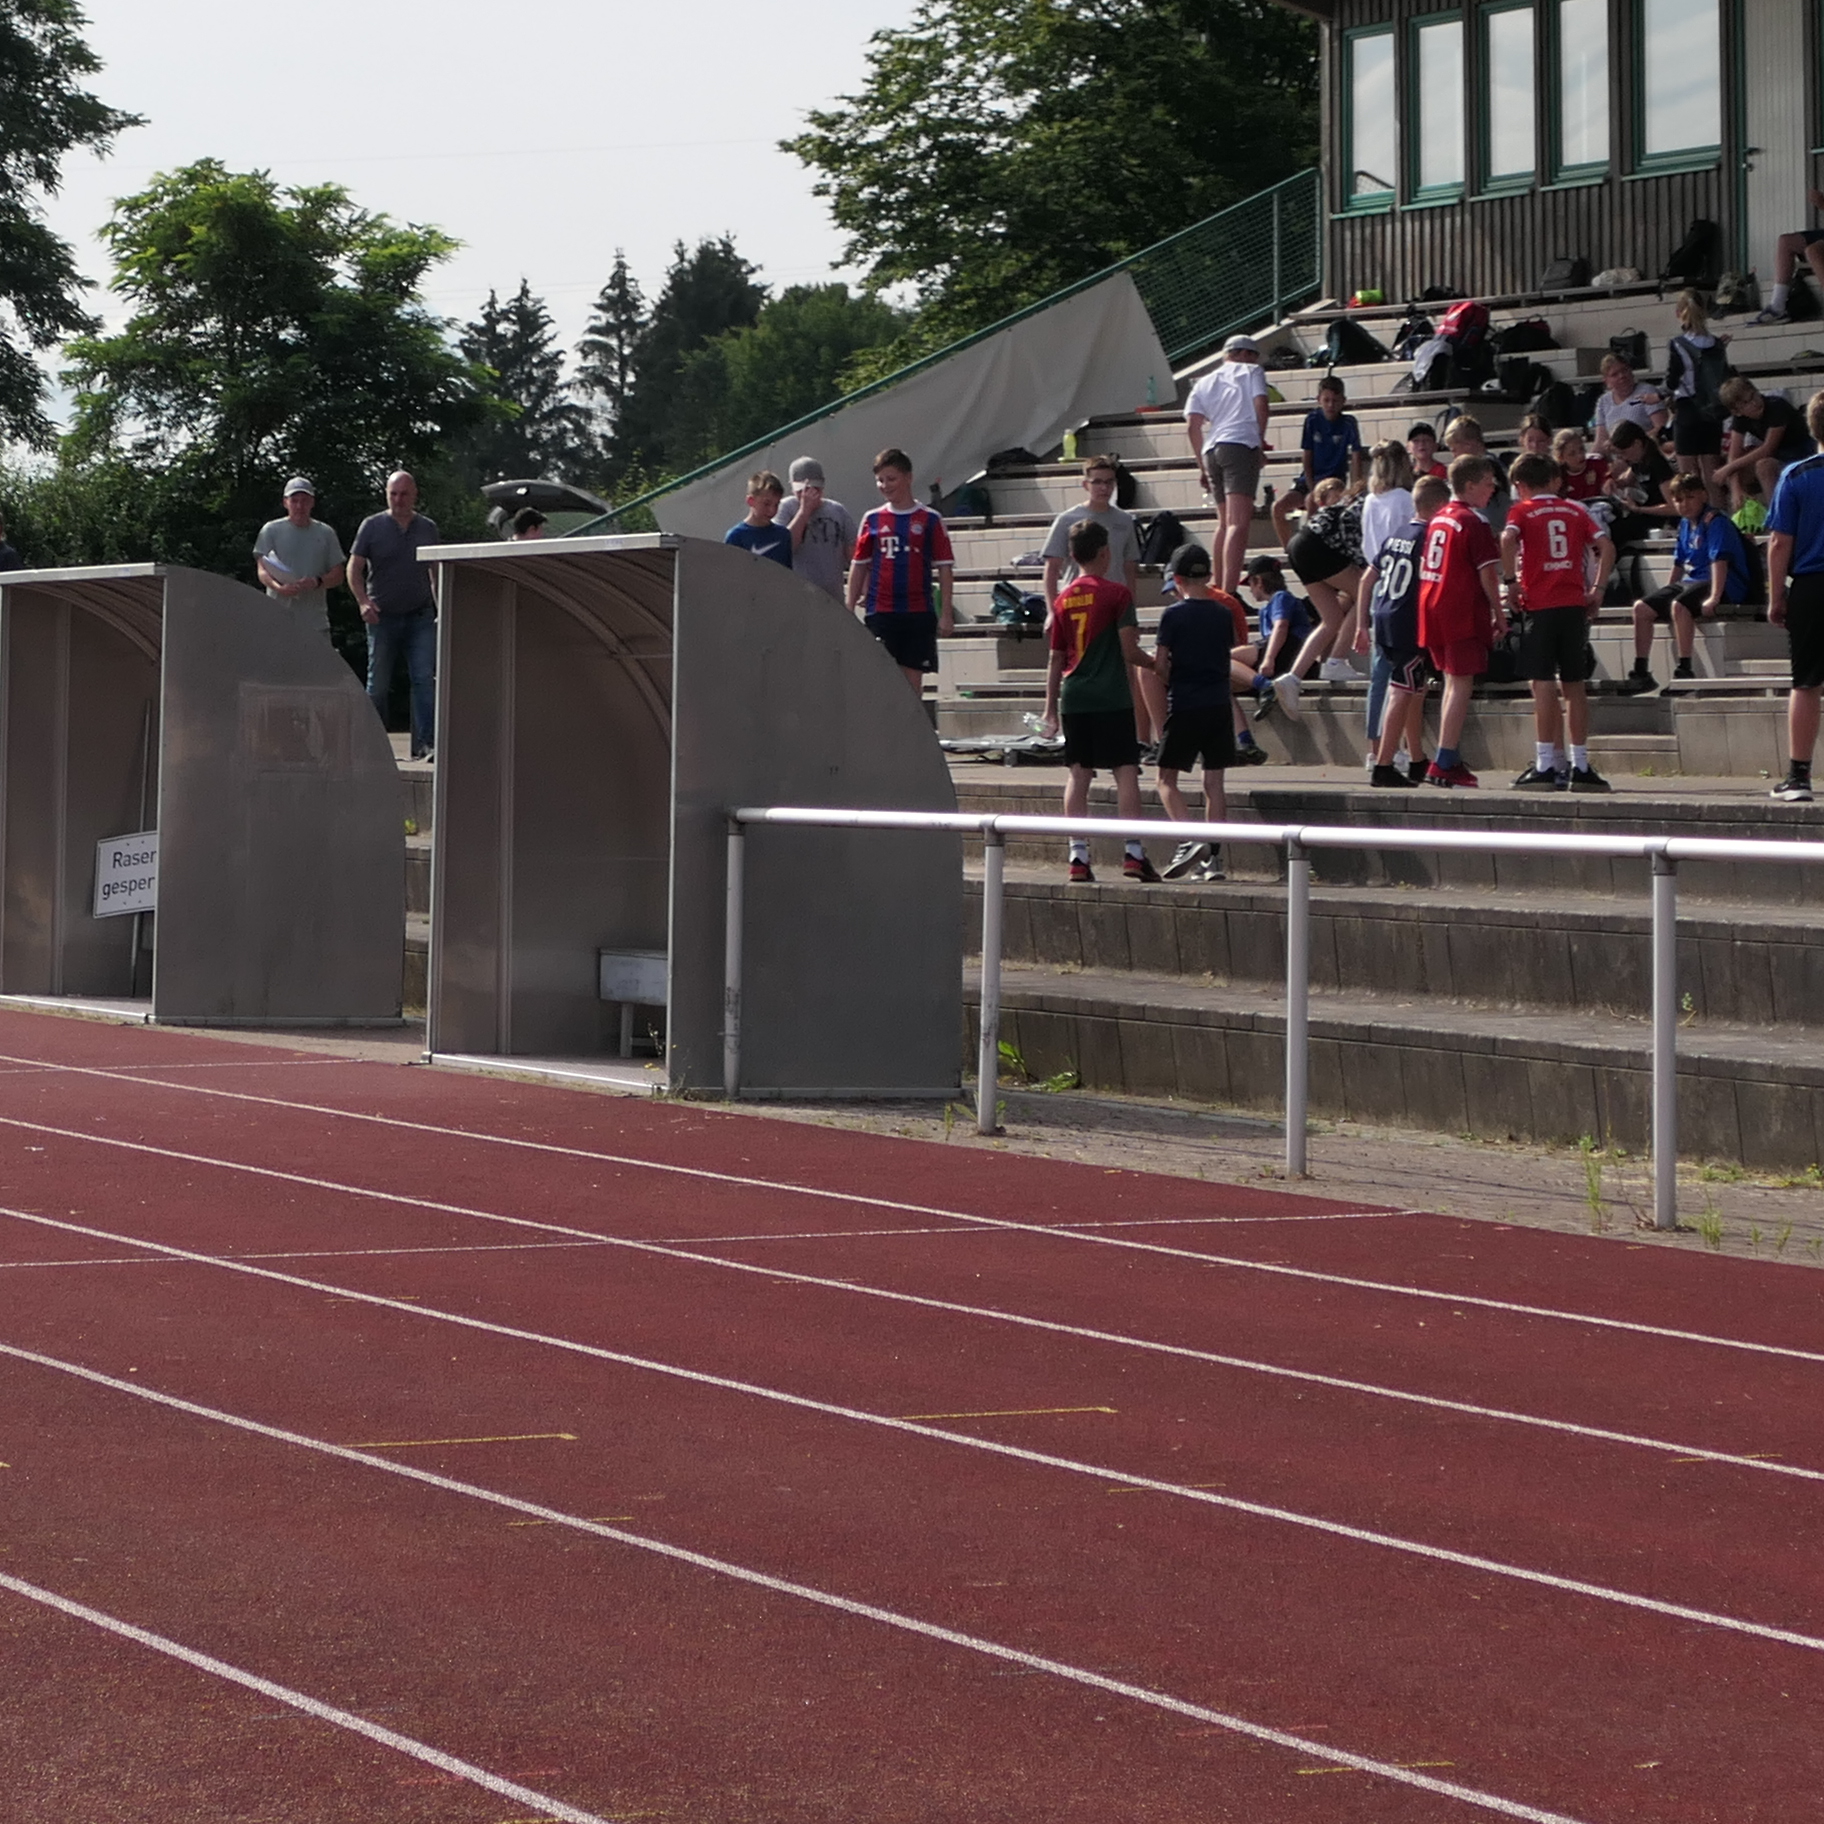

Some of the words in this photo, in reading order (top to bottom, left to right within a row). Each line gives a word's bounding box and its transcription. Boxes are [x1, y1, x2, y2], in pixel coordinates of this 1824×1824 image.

[1427, 529, 1446, 569] 6
[1547, 519, 1568, 559] 6
[1377, 554, 1413, 600] 30
[1070, 612, 1087, 658] 7
[102, 876, 155, 900] gesper
